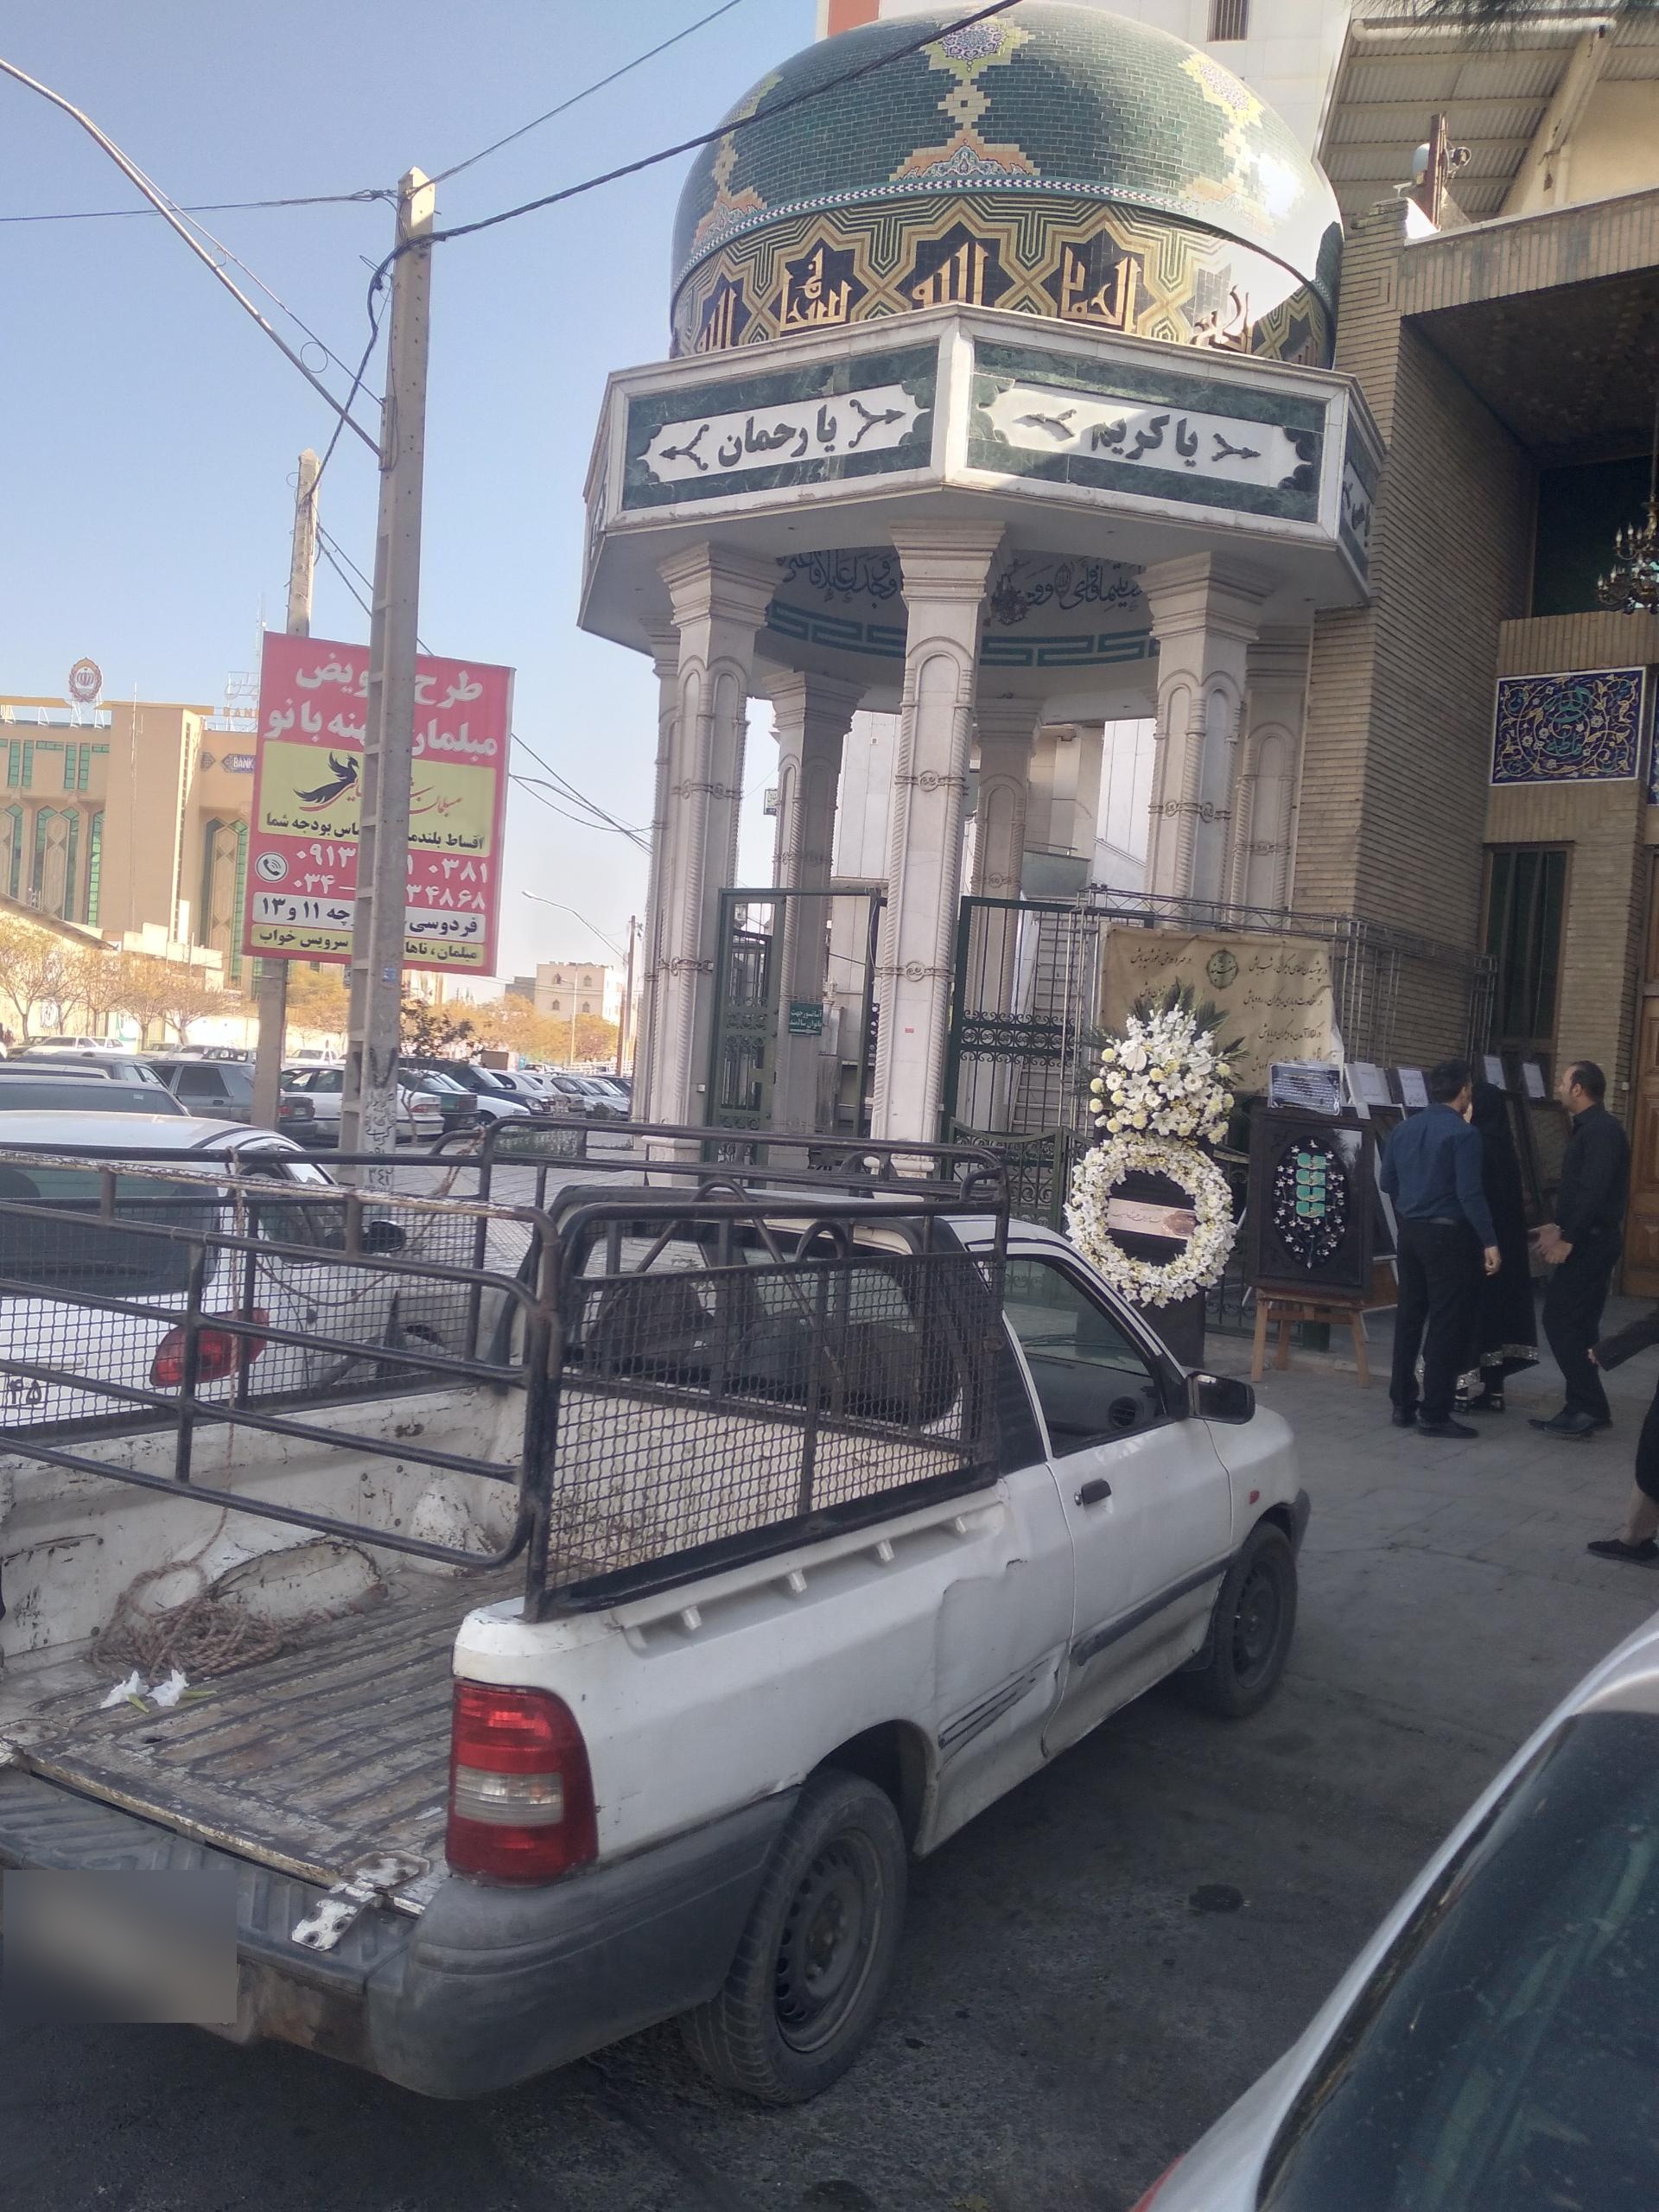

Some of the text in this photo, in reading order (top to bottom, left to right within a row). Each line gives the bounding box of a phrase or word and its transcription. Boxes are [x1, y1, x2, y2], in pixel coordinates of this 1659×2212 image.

[718, 404, 836, 467] یا رحمان
[1091, 414, 1198, 467] یا کریم
[295, 652, 483, 708] طرح ویض
[232, 756, 254, 770] BANK
[266, 813, 289, 828] شما
[292, 819, 332, 836] بودجه
[445, 833, 485, 849] اقساط
[428, 858, 488, 883] ۰۳۸۱
[406, 883, 486, 910] ۳۴۸۶۸
[259, 929, 296, 945] خواب
[409, 917, 478, 938] فردوسی
[300, 937, 349, 950] سرویس
